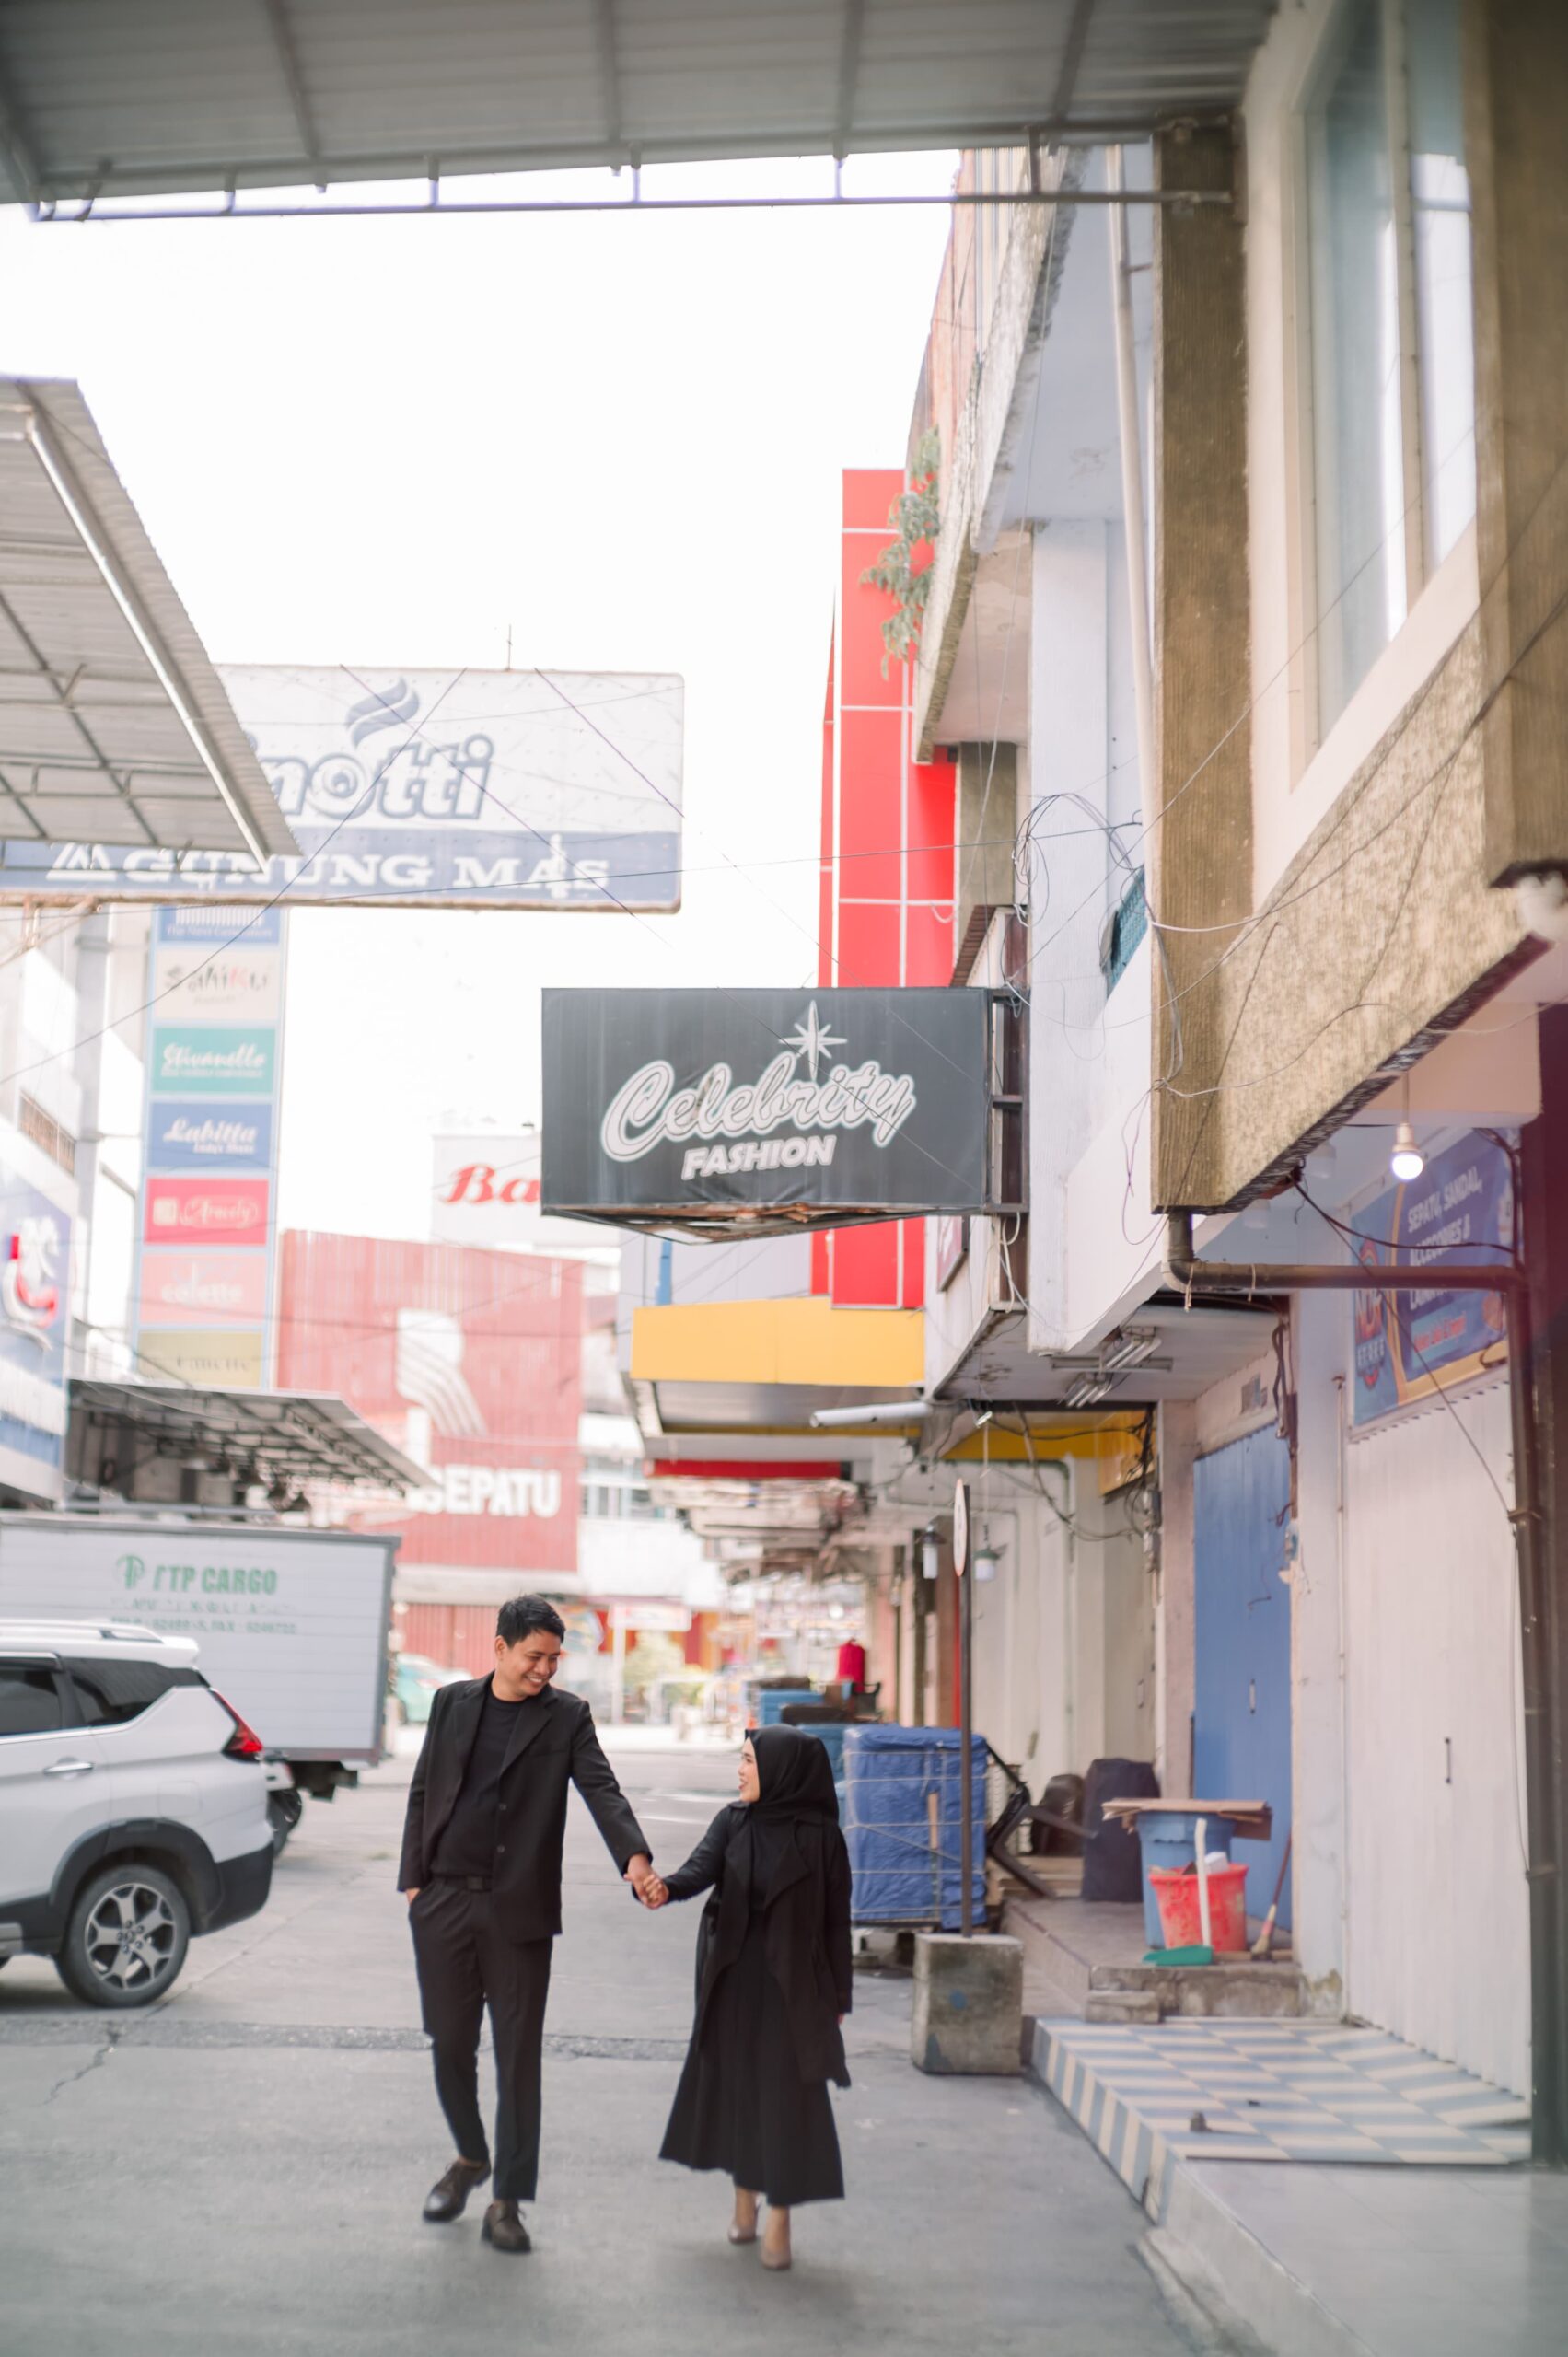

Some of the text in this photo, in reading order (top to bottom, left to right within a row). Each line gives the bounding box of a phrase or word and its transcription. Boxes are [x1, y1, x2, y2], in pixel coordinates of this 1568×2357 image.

[249, 734, 495, 820] notti
[453, 856, 610, 890] MAS
[600, 1051, 916, 1163] Celebrity
[681, 1134, 836, 1181] FASHION
[439, 1162, 541, 1205] Ba
[200, 1566, 279, 1596] CARGO
